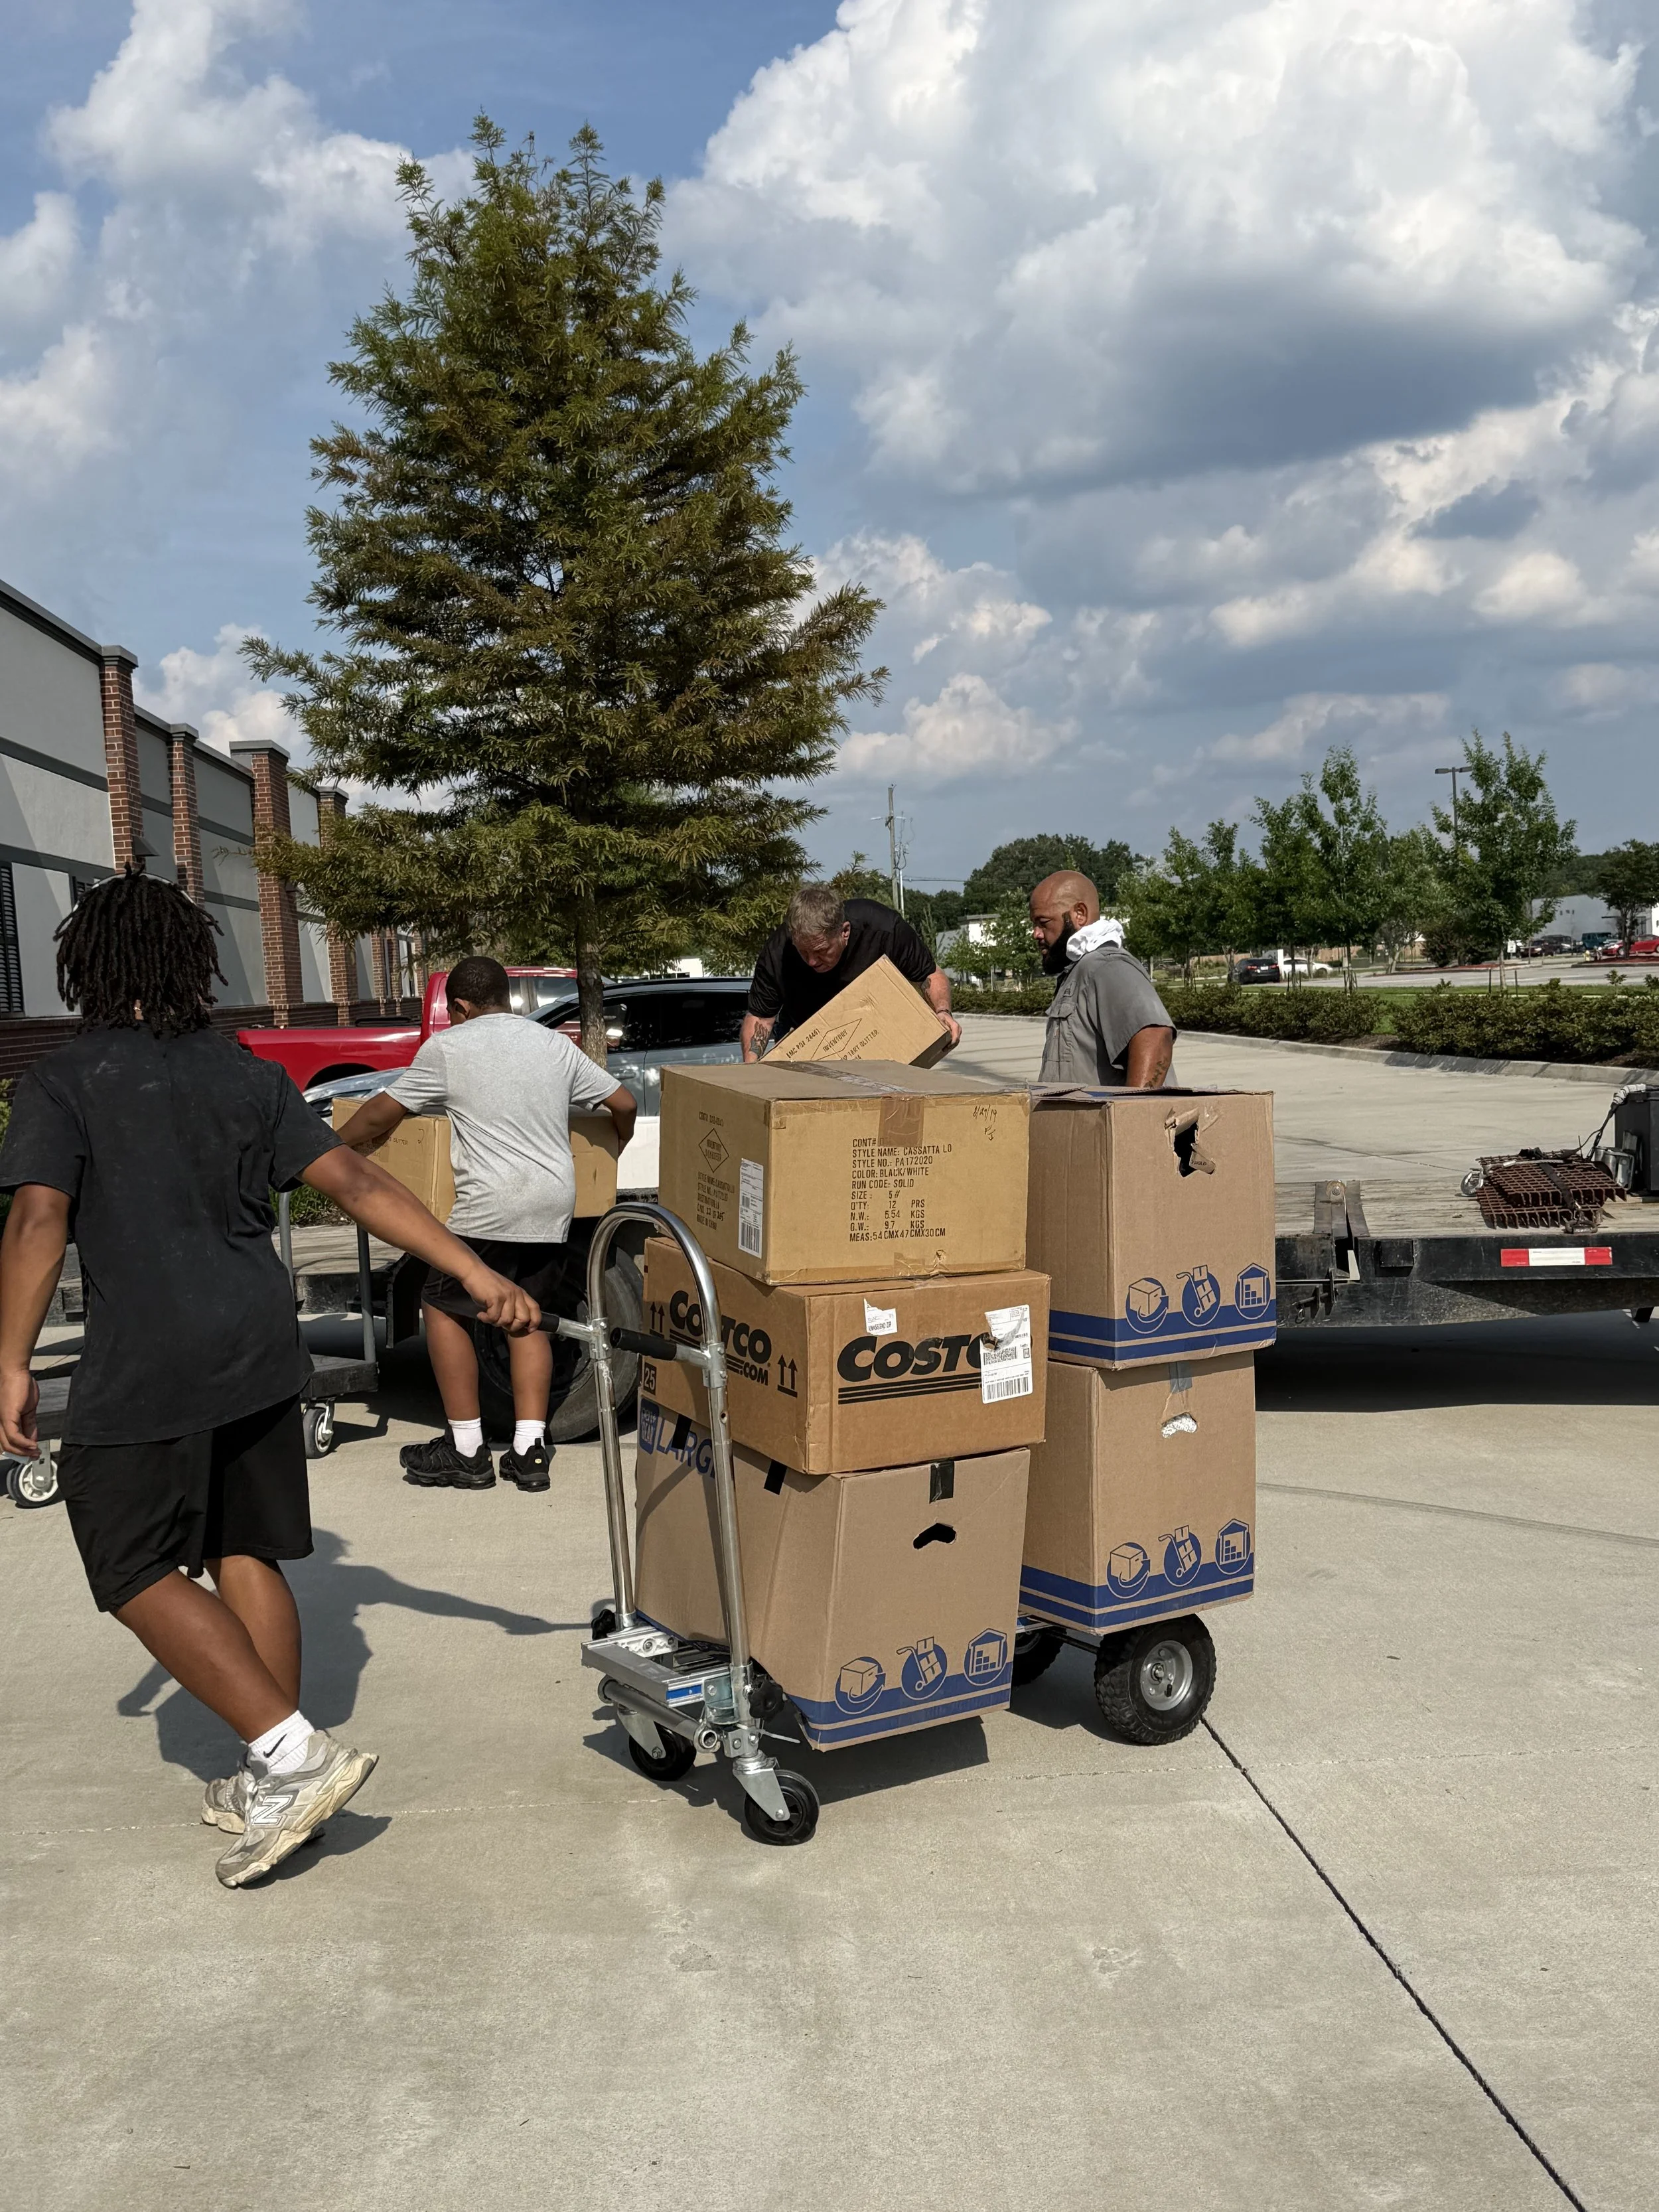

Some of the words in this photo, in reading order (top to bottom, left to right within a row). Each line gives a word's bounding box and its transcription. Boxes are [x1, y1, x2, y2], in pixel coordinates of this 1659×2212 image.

[852, 1148, 875, 1158] STYLE
[877, 1147, 900, 1157] NAME:
[903, 1145, 940, 1156] CASSATTA
[852, 1159, 875, 1169] STYLE
[895, 1156, 933, 1167] PA172020
[852, 1169, 878, 1179] COLOR:
[879, 1167, 929, 1178] BLACK/WHITE
[851, 1180, 867, 1189] RUN
[869, 1179, 891, 1189] CODE:
[893, 1179, 914, 1188] SOLID
[889, 1201, 897, 1209] 12
[911, 1199, 925, 1209] PRS
[910, 1210, 925, 1218] KGS
[910, 1220, 925, 1229] KGS
[670, 1290, 771, 1364] COTCO
[837, 1332, 1033, 1382] COST
[644, 1367, 656, 1391] 25
[740, 1362, 768, 1386] .COM
[656, 1418, 715, 1479] LRG
